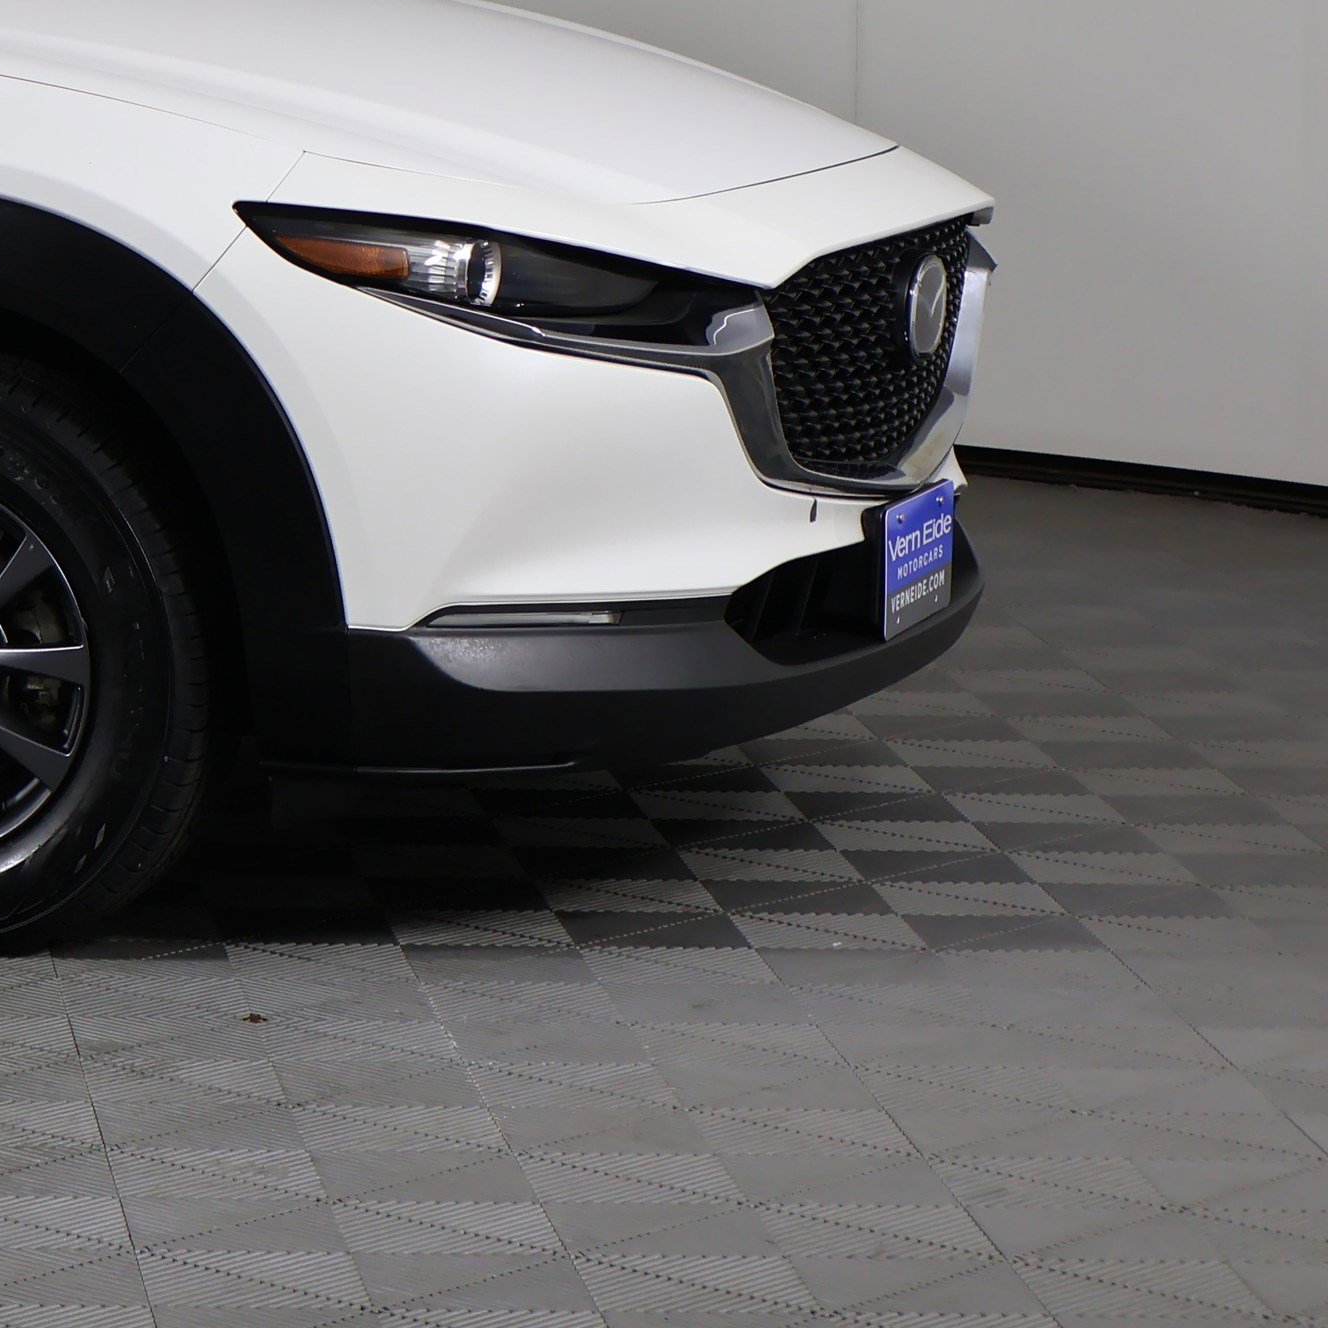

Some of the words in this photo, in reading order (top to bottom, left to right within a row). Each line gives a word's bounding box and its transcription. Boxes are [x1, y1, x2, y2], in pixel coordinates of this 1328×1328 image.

[888, 529, 921, 562] Vern
[923, 513, 952, 545] Eide
[897, 544, 944, 580] MOTORCARS
[891, 569, 946, 615] VERNEIDE.COM
